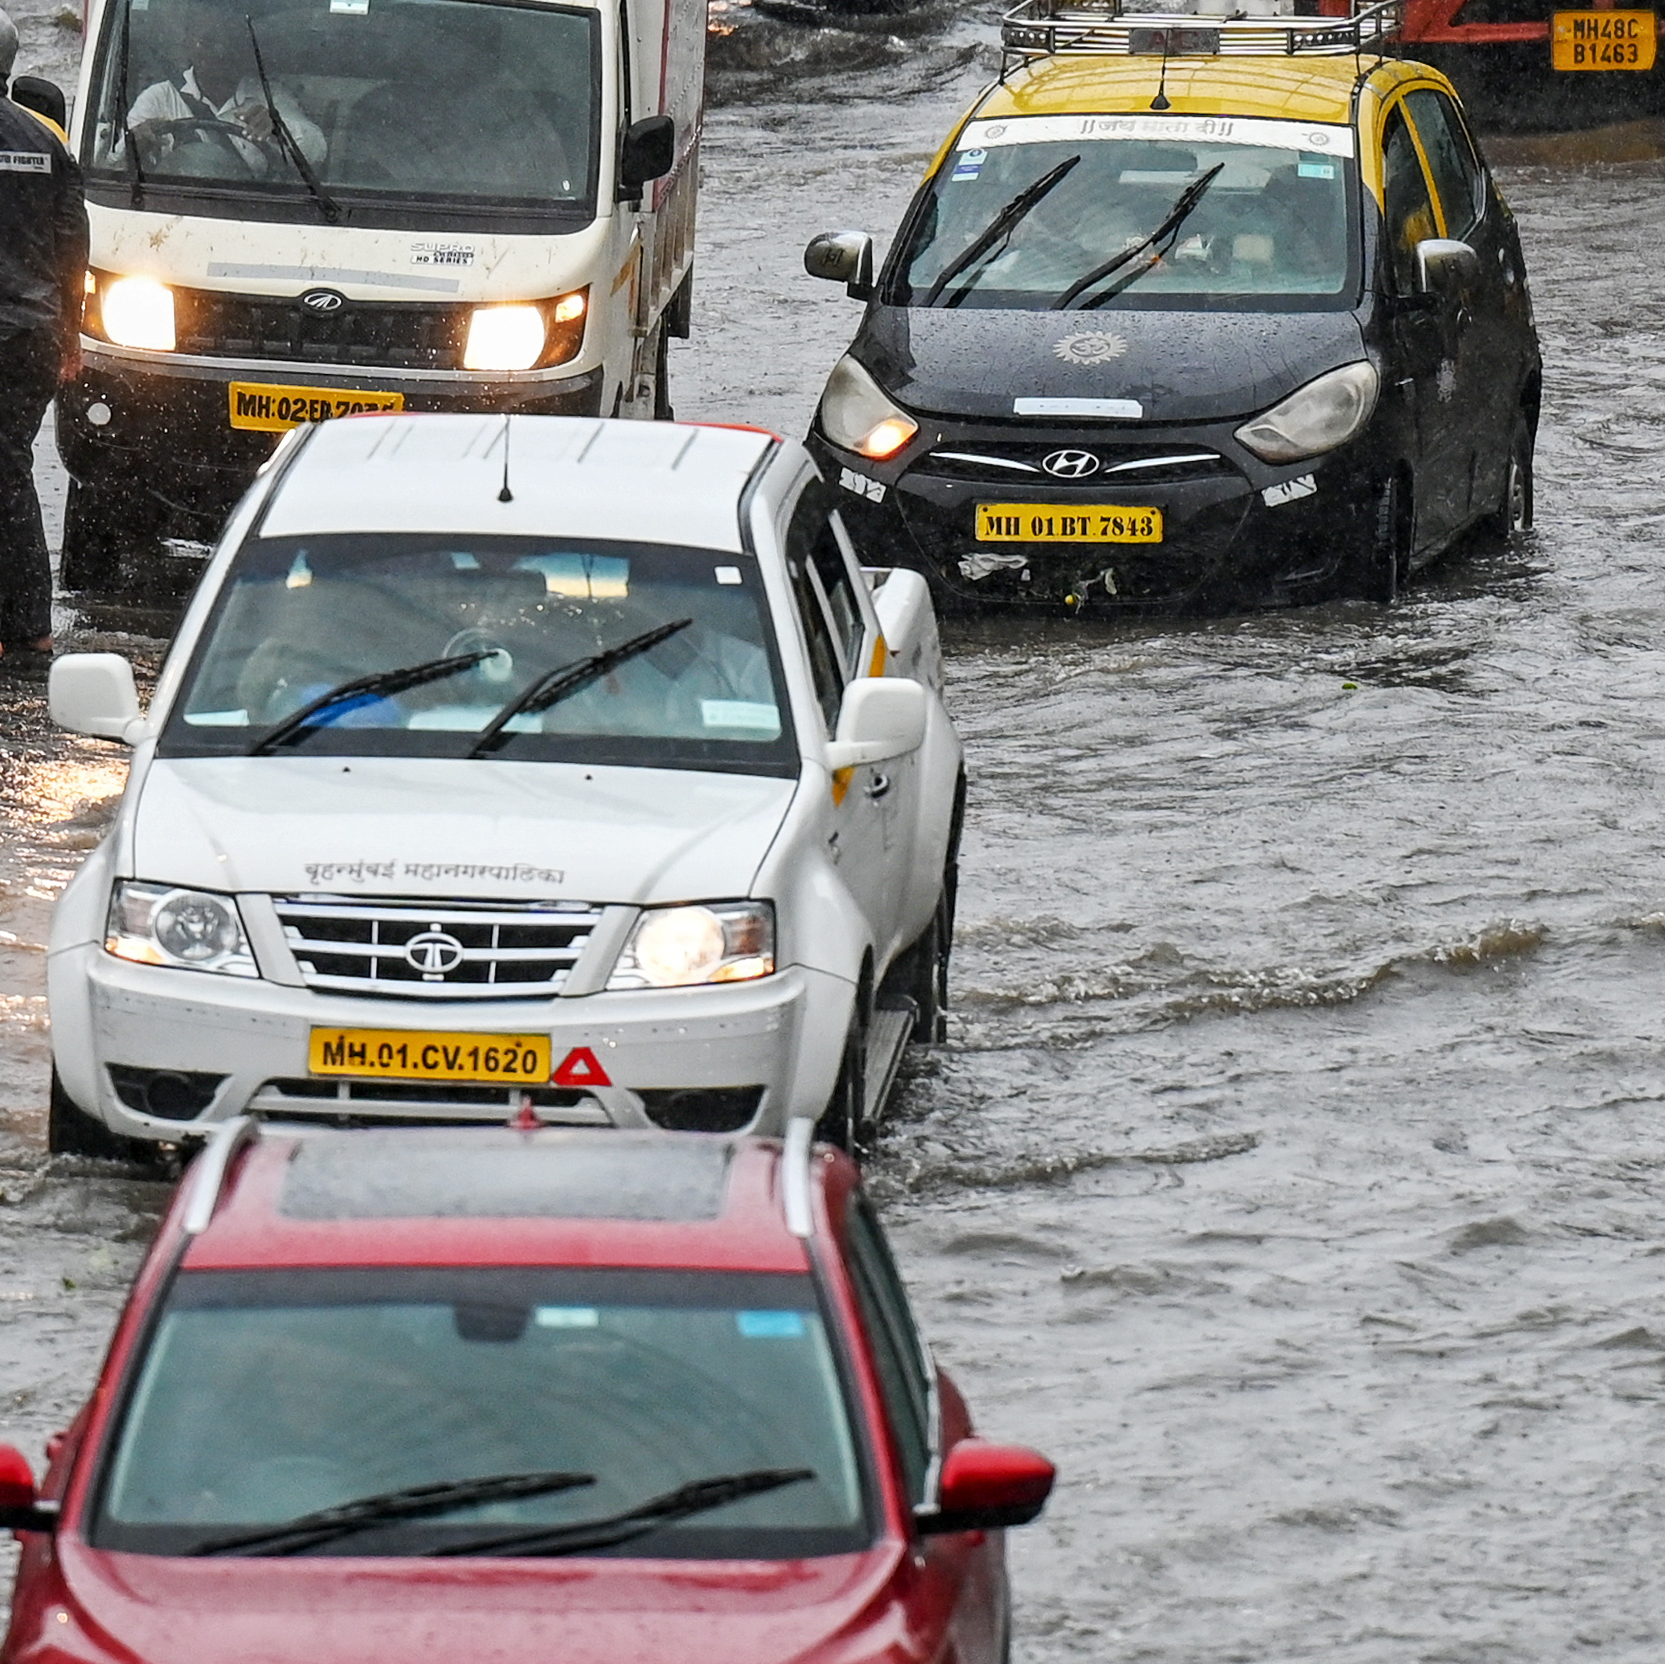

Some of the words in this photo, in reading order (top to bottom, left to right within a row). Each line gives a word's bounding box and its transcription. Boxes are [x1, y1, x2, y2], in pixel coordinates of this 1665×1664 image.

[1573, 18, 1639, 40] MH48C
[1573, 42, 1639, 65] B1463
[410, 242, 476, 252] SUPRO
[433, 256, 468, 264] SERIES
[985, 516, 1020, 536] MH
